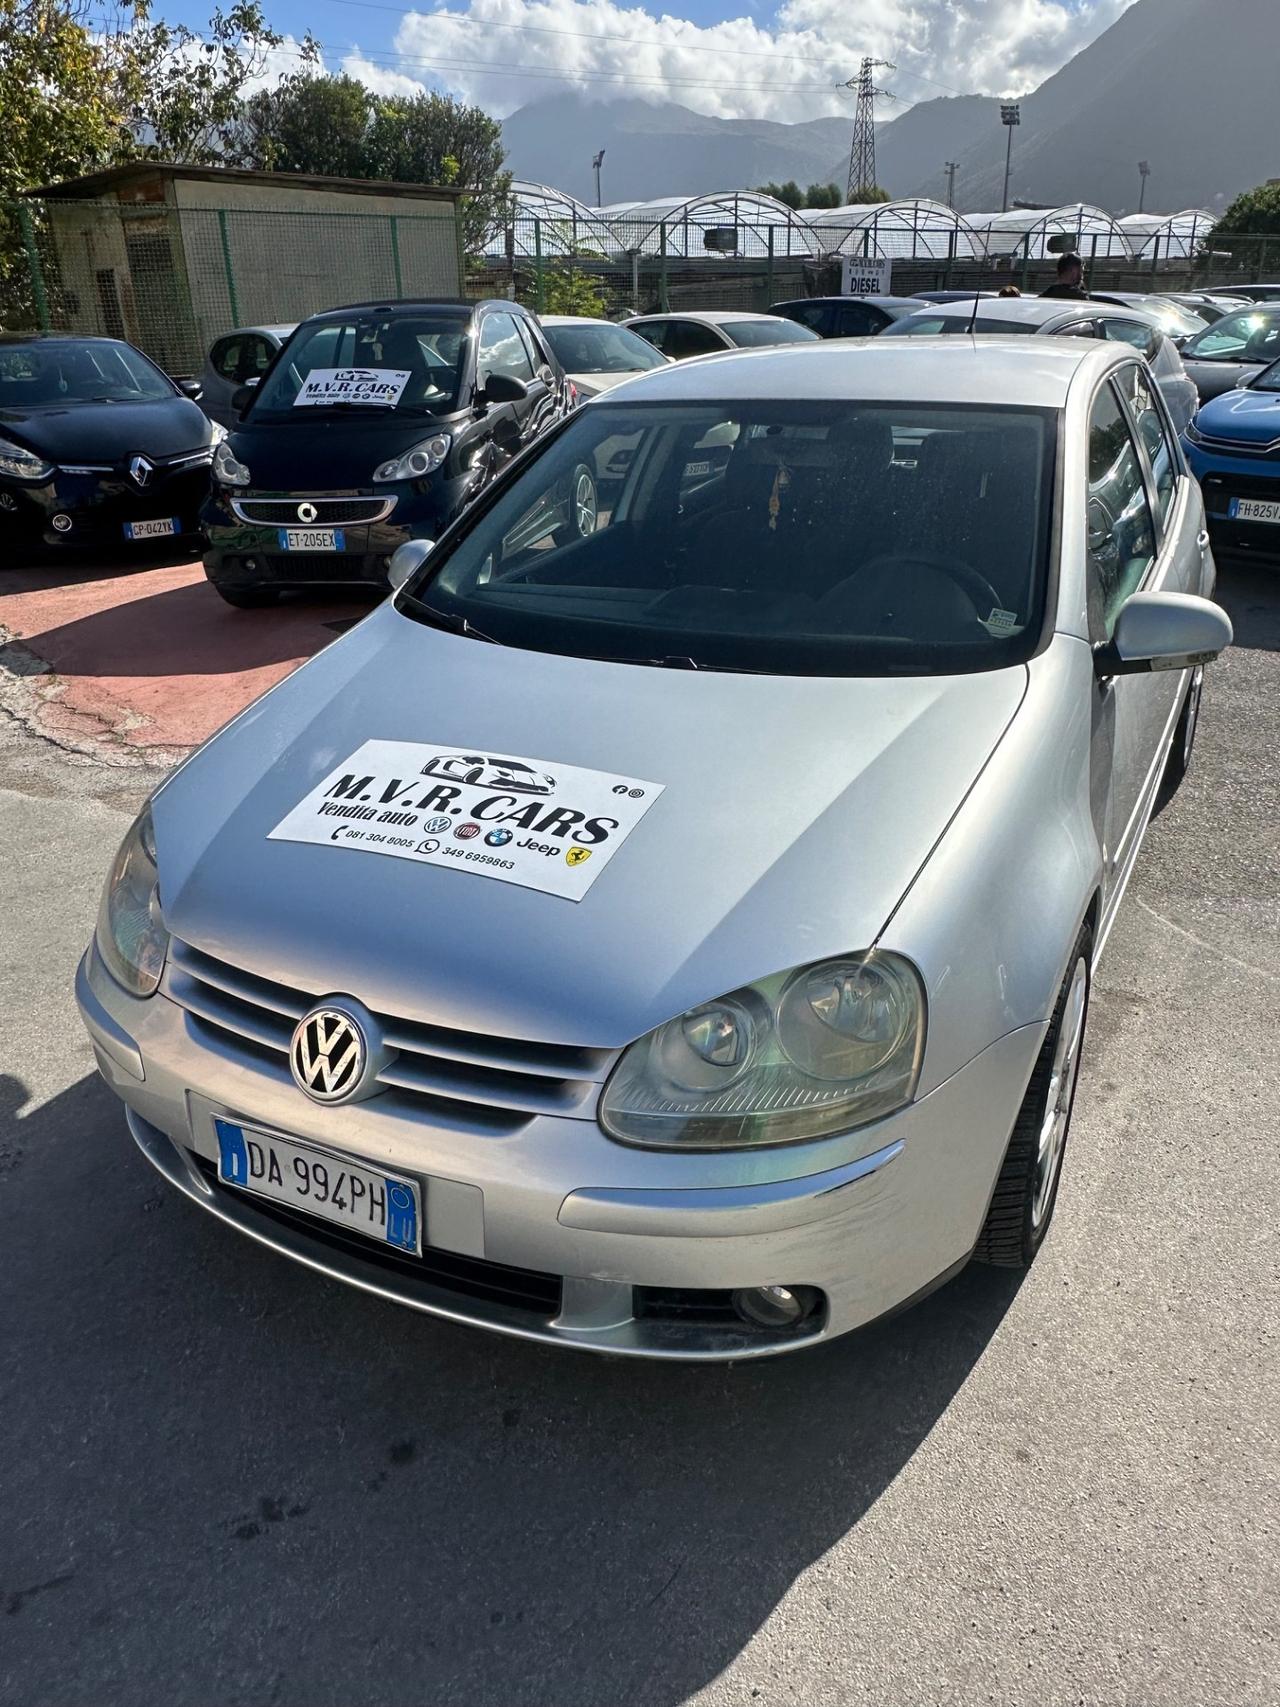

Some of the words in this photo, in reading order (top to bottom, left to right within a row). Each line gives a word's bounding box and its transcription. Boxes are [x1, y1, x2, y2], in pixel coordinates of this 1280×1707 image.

[850, 277, 881, 294] DIESEL
[355, 383, 400, 395] CARS
[317, 801, 378, 820] Vendita
[376, 810, 418, 826] auto
[516, 838, 561, 857] Jeep
[323, 774, 462, 815] M.V.R.
[470, 795, 620, 845] CARS
[345, 830, 366, 839] 081
[366, 833, 387, 843] 304
[386, 837, 415, 848] 8005
[442, 847, 465, 858] 349
[465, 851, 516, 870] 6959863
[247, 1140, 283, 1187] DA
[292, 1156, 386, 1226] 994PH
